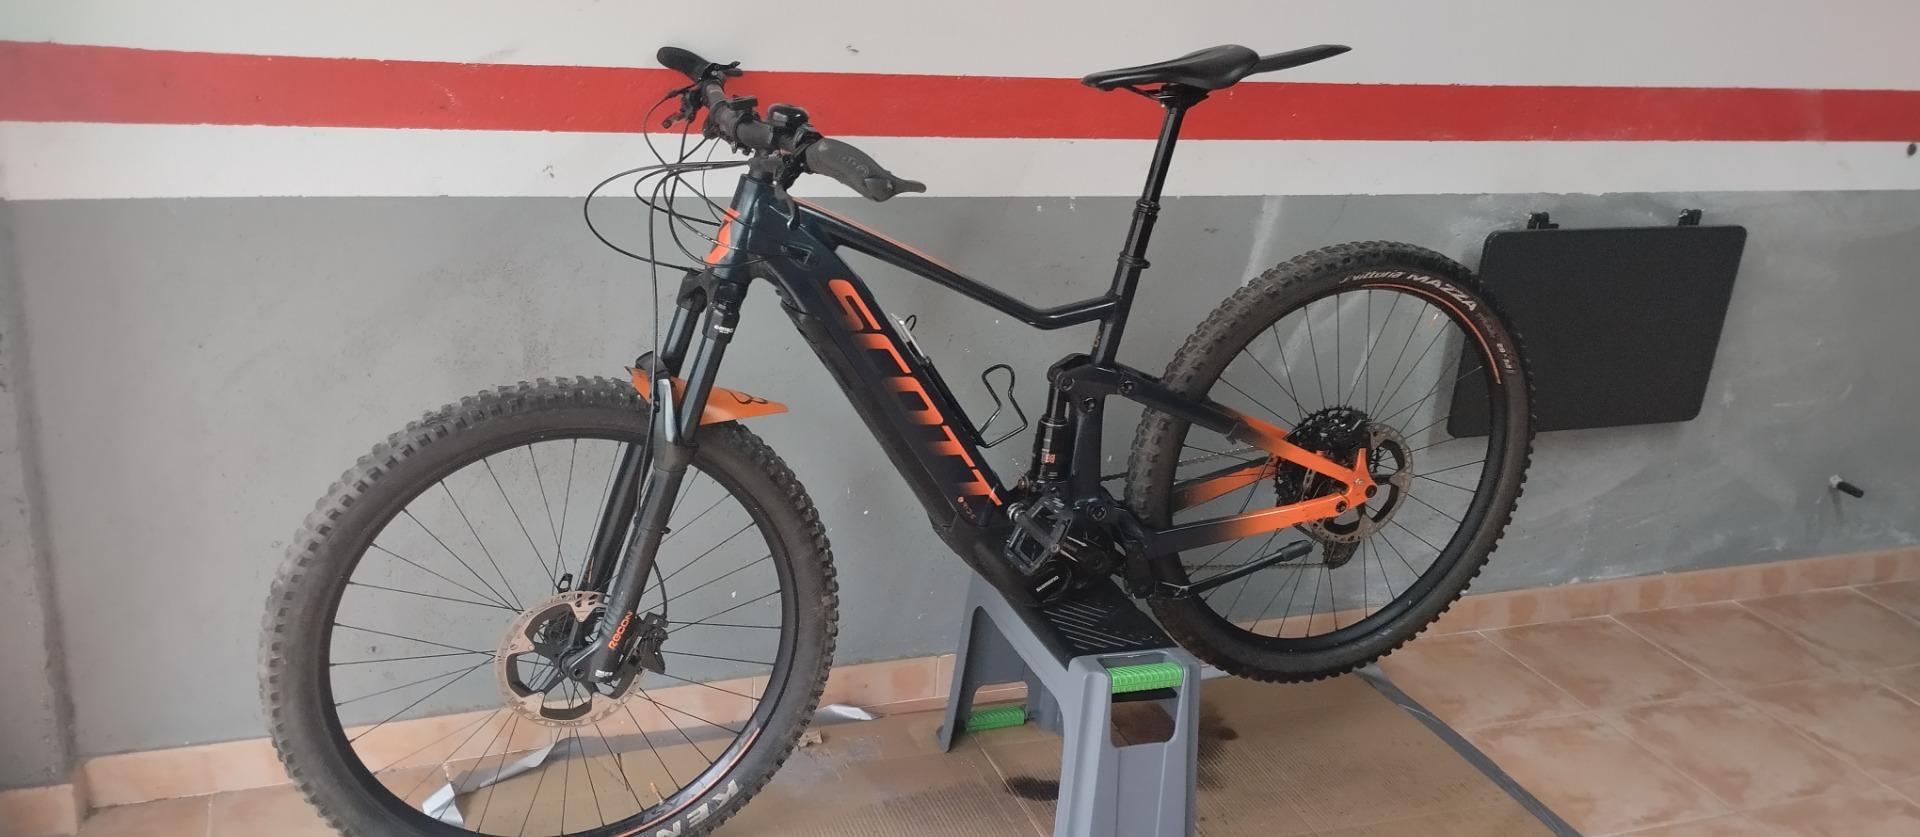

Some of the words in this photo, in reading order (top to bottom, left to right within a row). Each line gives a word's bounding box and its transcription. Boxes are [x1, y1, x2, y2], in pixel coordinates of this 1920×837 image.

[1406, 274, 1478, 312] MAZZA
[828, 279, 1002, 506] SCOTT
[608, 609, 634, 651] RECON
